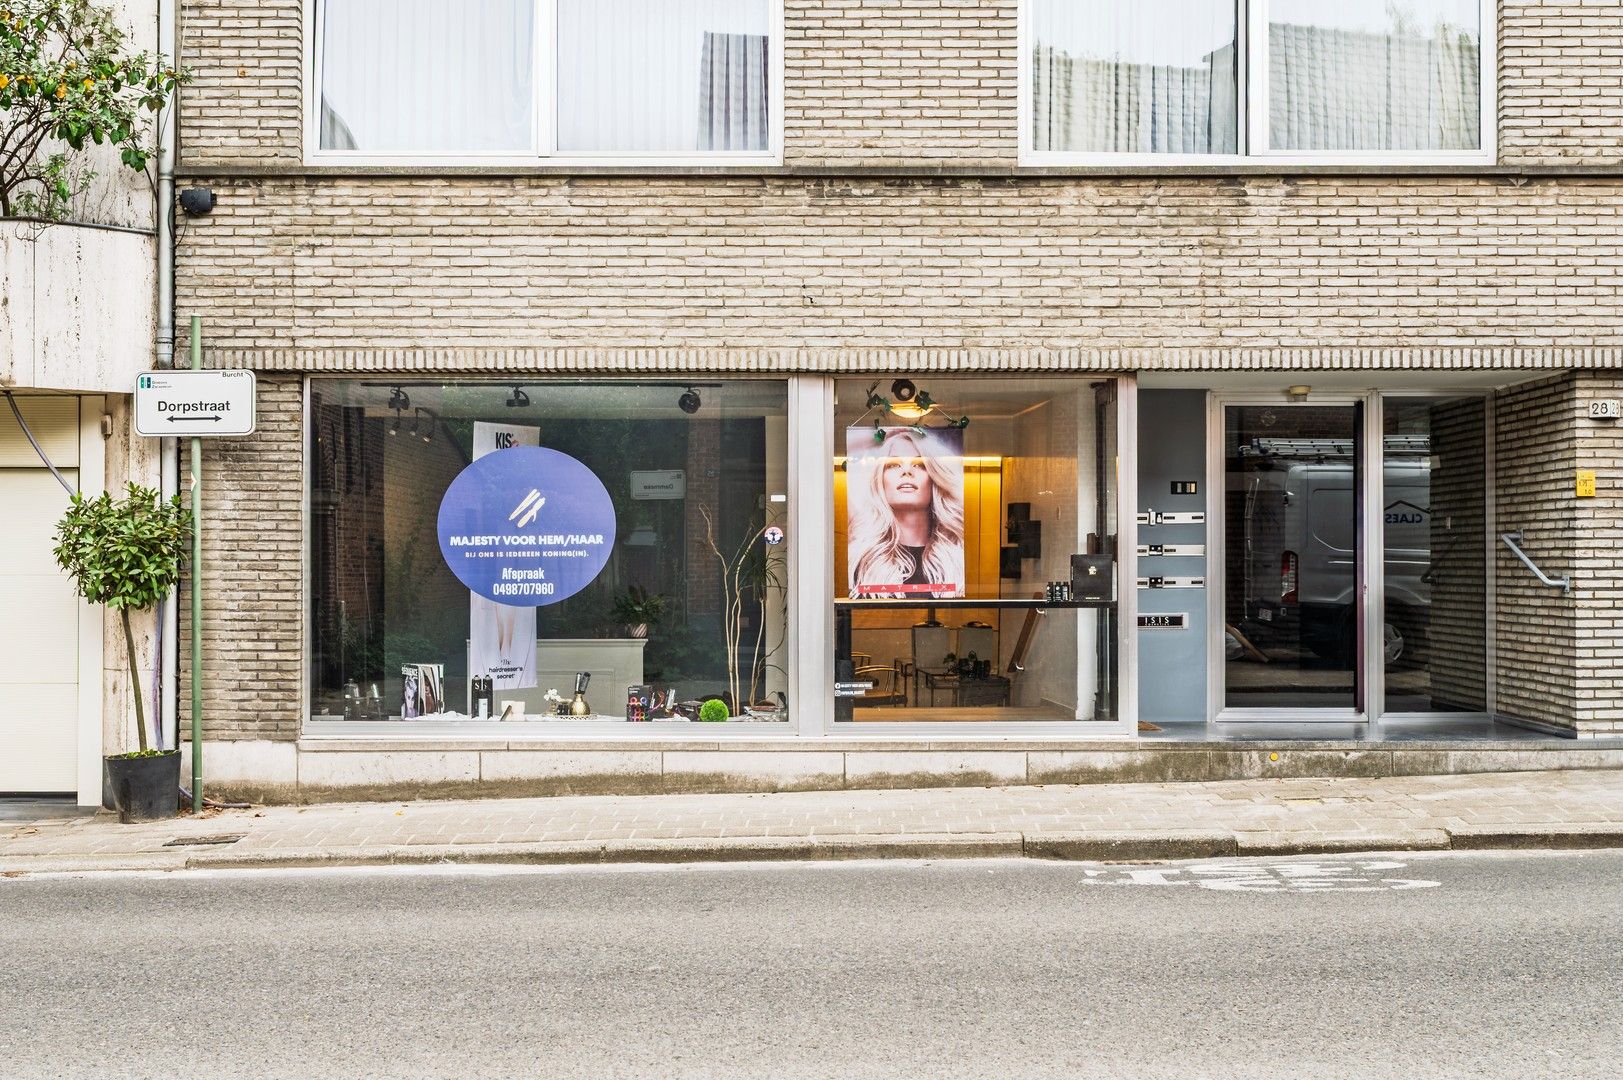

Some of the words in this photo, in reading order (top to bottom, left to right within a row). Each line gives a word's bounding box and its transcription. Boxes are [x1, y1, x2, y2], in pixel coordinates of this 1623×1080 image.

[157, 400, 231, 414] Dorpstraat
[1591, 402, 1609, 415] 28
[449, 535, 501, 546] MAJESTY
[502, 535, 537, 546] VOOR
[538, 534, 604, 547] HEM/HAAR
[502, 567, 545, 581] Afspraak
[493, 582, 554, 596] 0498707960
[863, 584, 948, 592] MATRIX
[1145, 616, 1170, 624] ISIS
